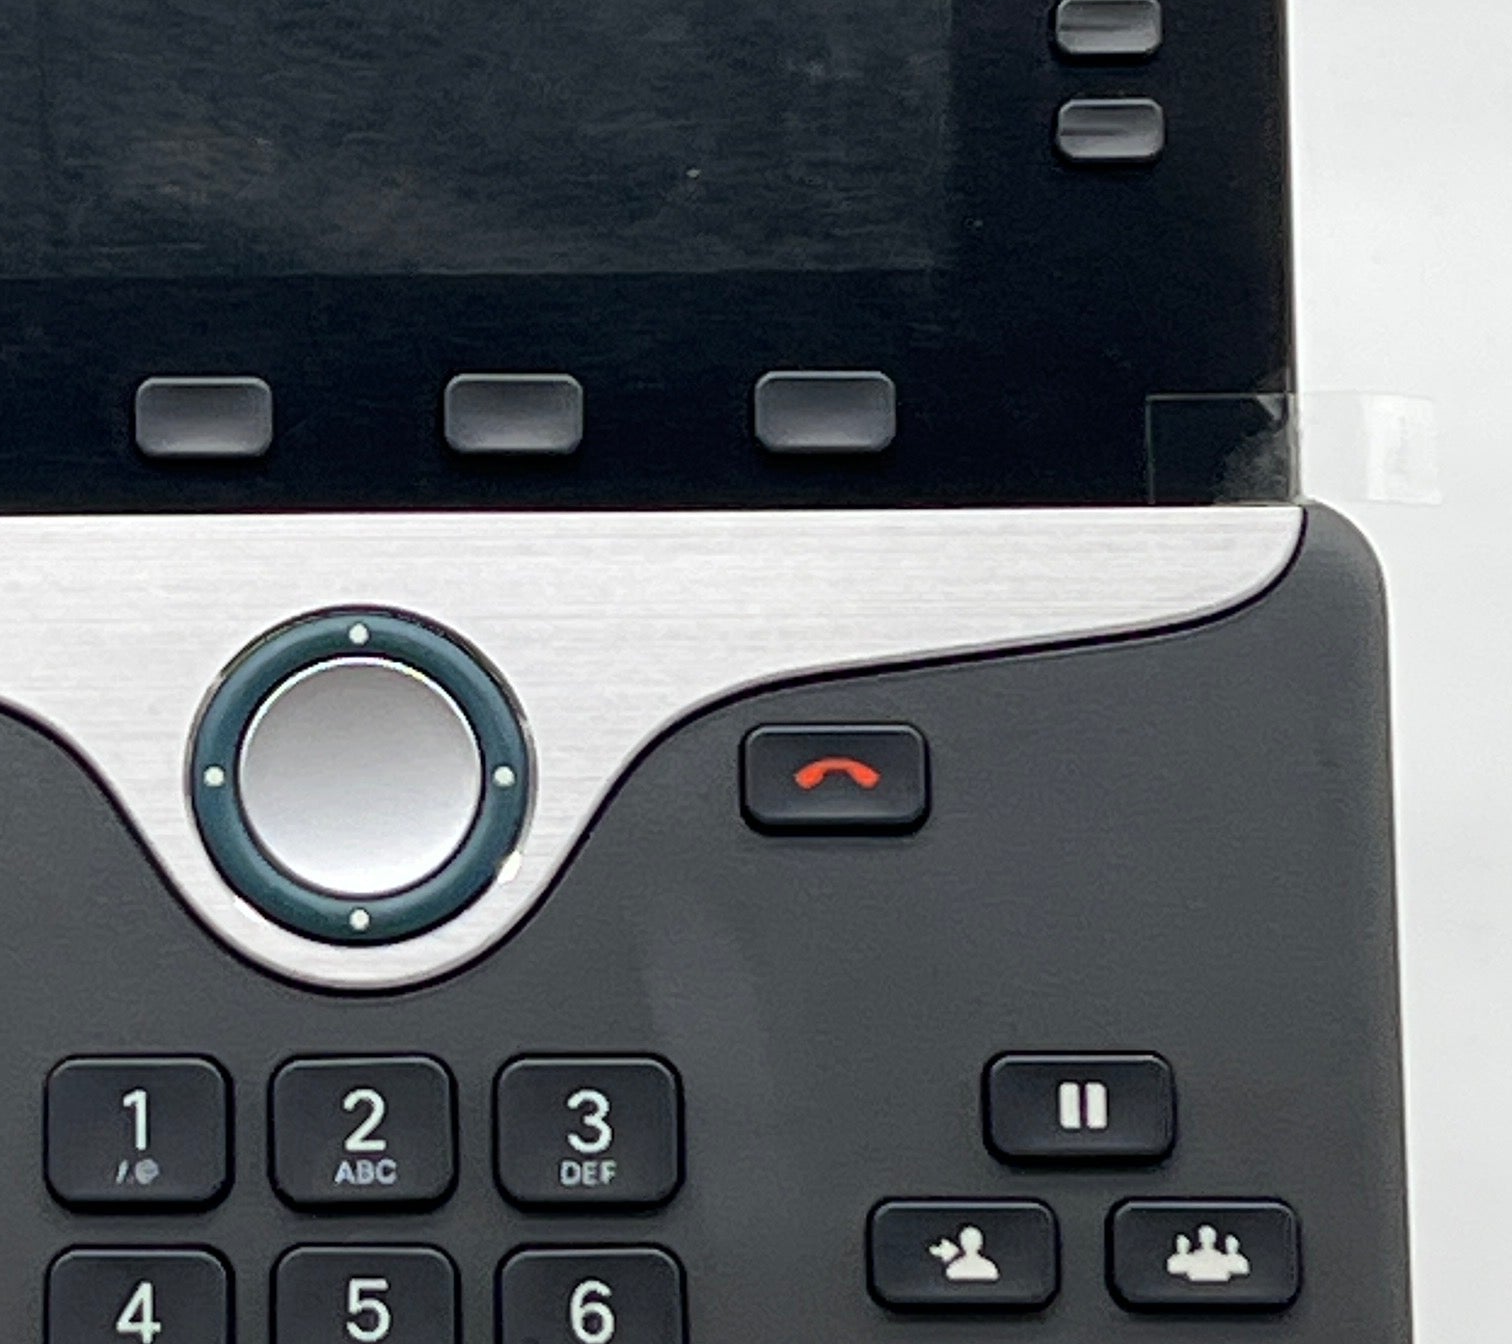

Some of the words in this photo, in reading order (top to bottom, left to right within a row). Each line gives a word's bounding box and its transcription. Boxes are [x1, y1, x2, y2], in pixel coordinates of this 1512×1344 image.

[123, 1089, 147, 1151] 1
[343, 1089, 387, 1152] 2
[567, 1090, 612, 1153] 3
[334, 1158, 397, 1185] ABC
[560, 1160, 617, 1186] DEF
[116, 1282, 162, 1344] 4
[346, 1278, 391, 1342] 5
[570, 1280, 615, 1344] 6
